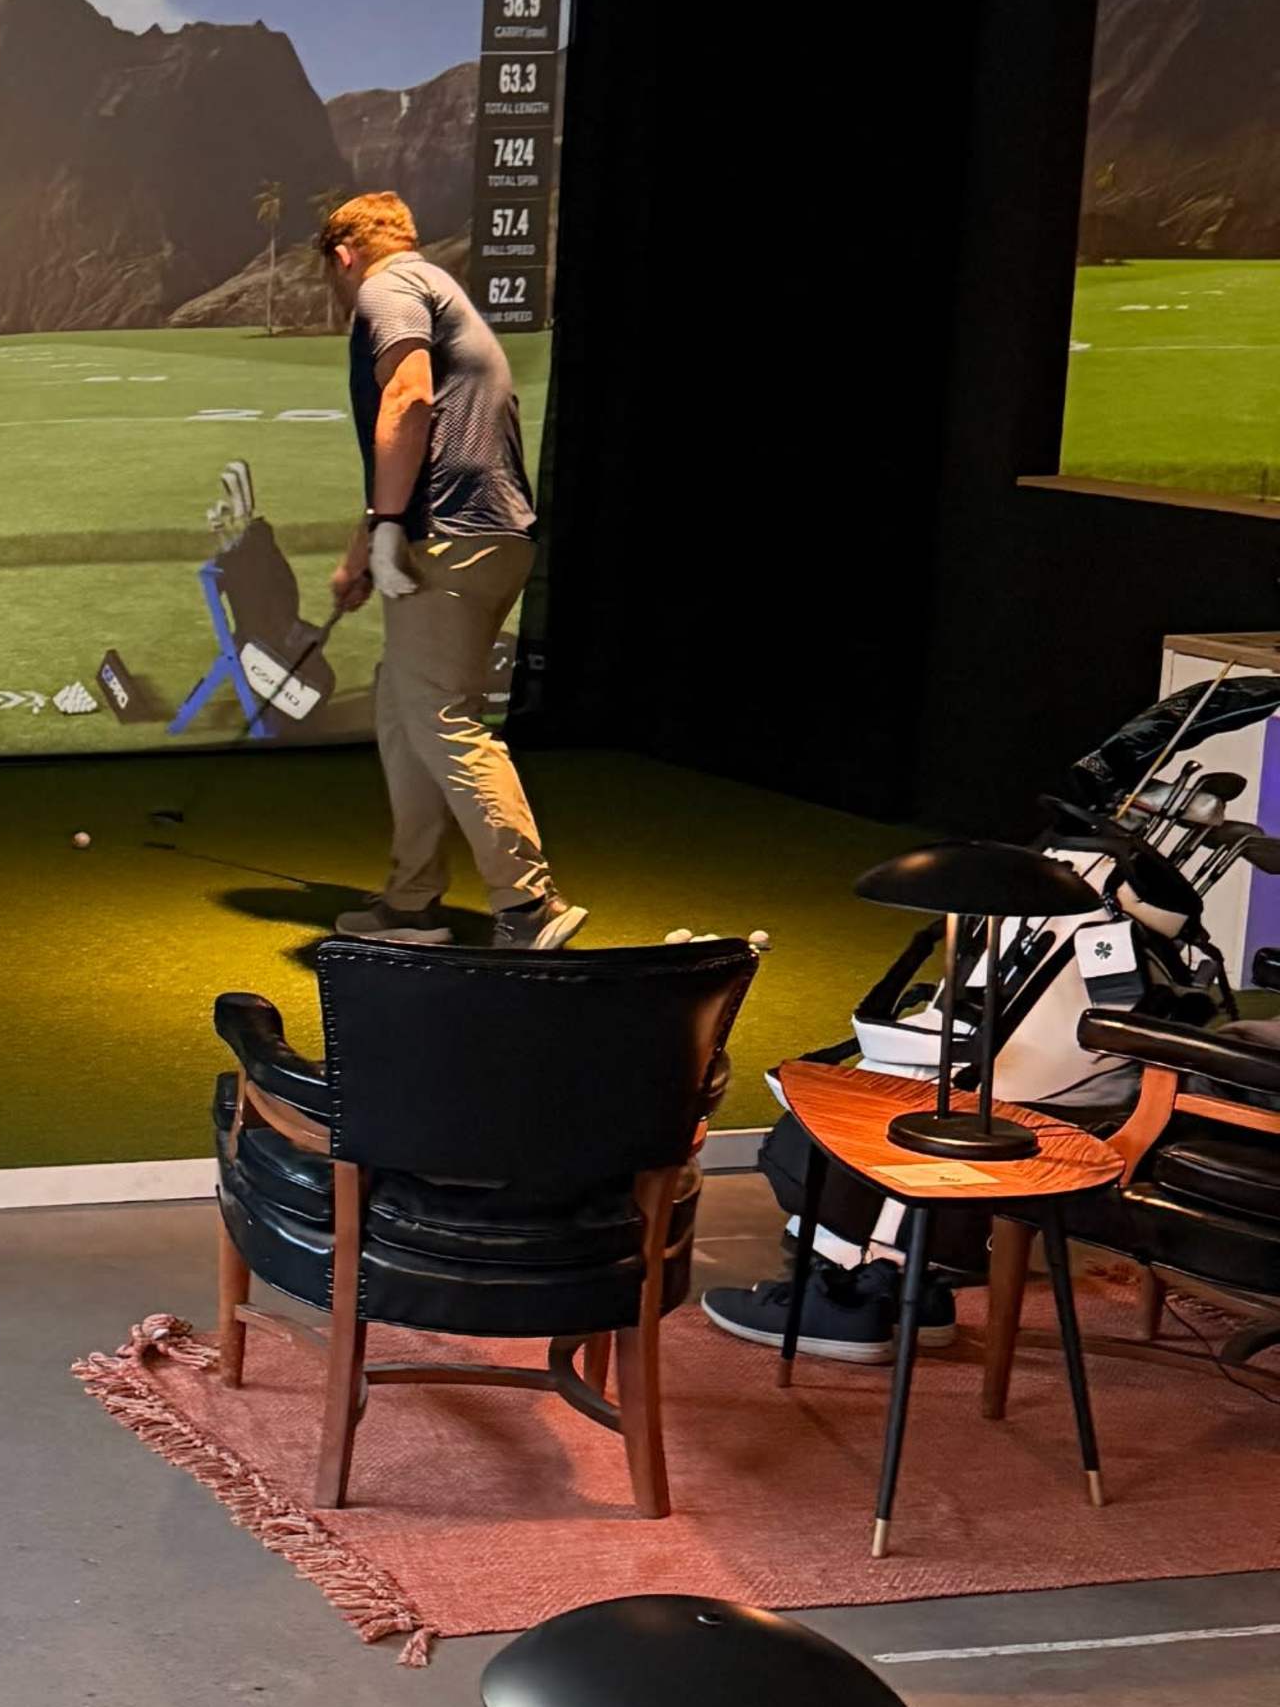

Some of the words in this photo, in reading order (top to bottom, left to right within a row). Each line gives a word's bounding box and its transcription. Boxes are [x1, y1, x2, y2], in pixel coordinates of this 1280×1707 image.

[499, 63, 537, 94] 63.3
[493, 138, 535, 167] 7424
[492, 208, 529, 236] 57.4
[488, 276, 527, 304] 62.2
